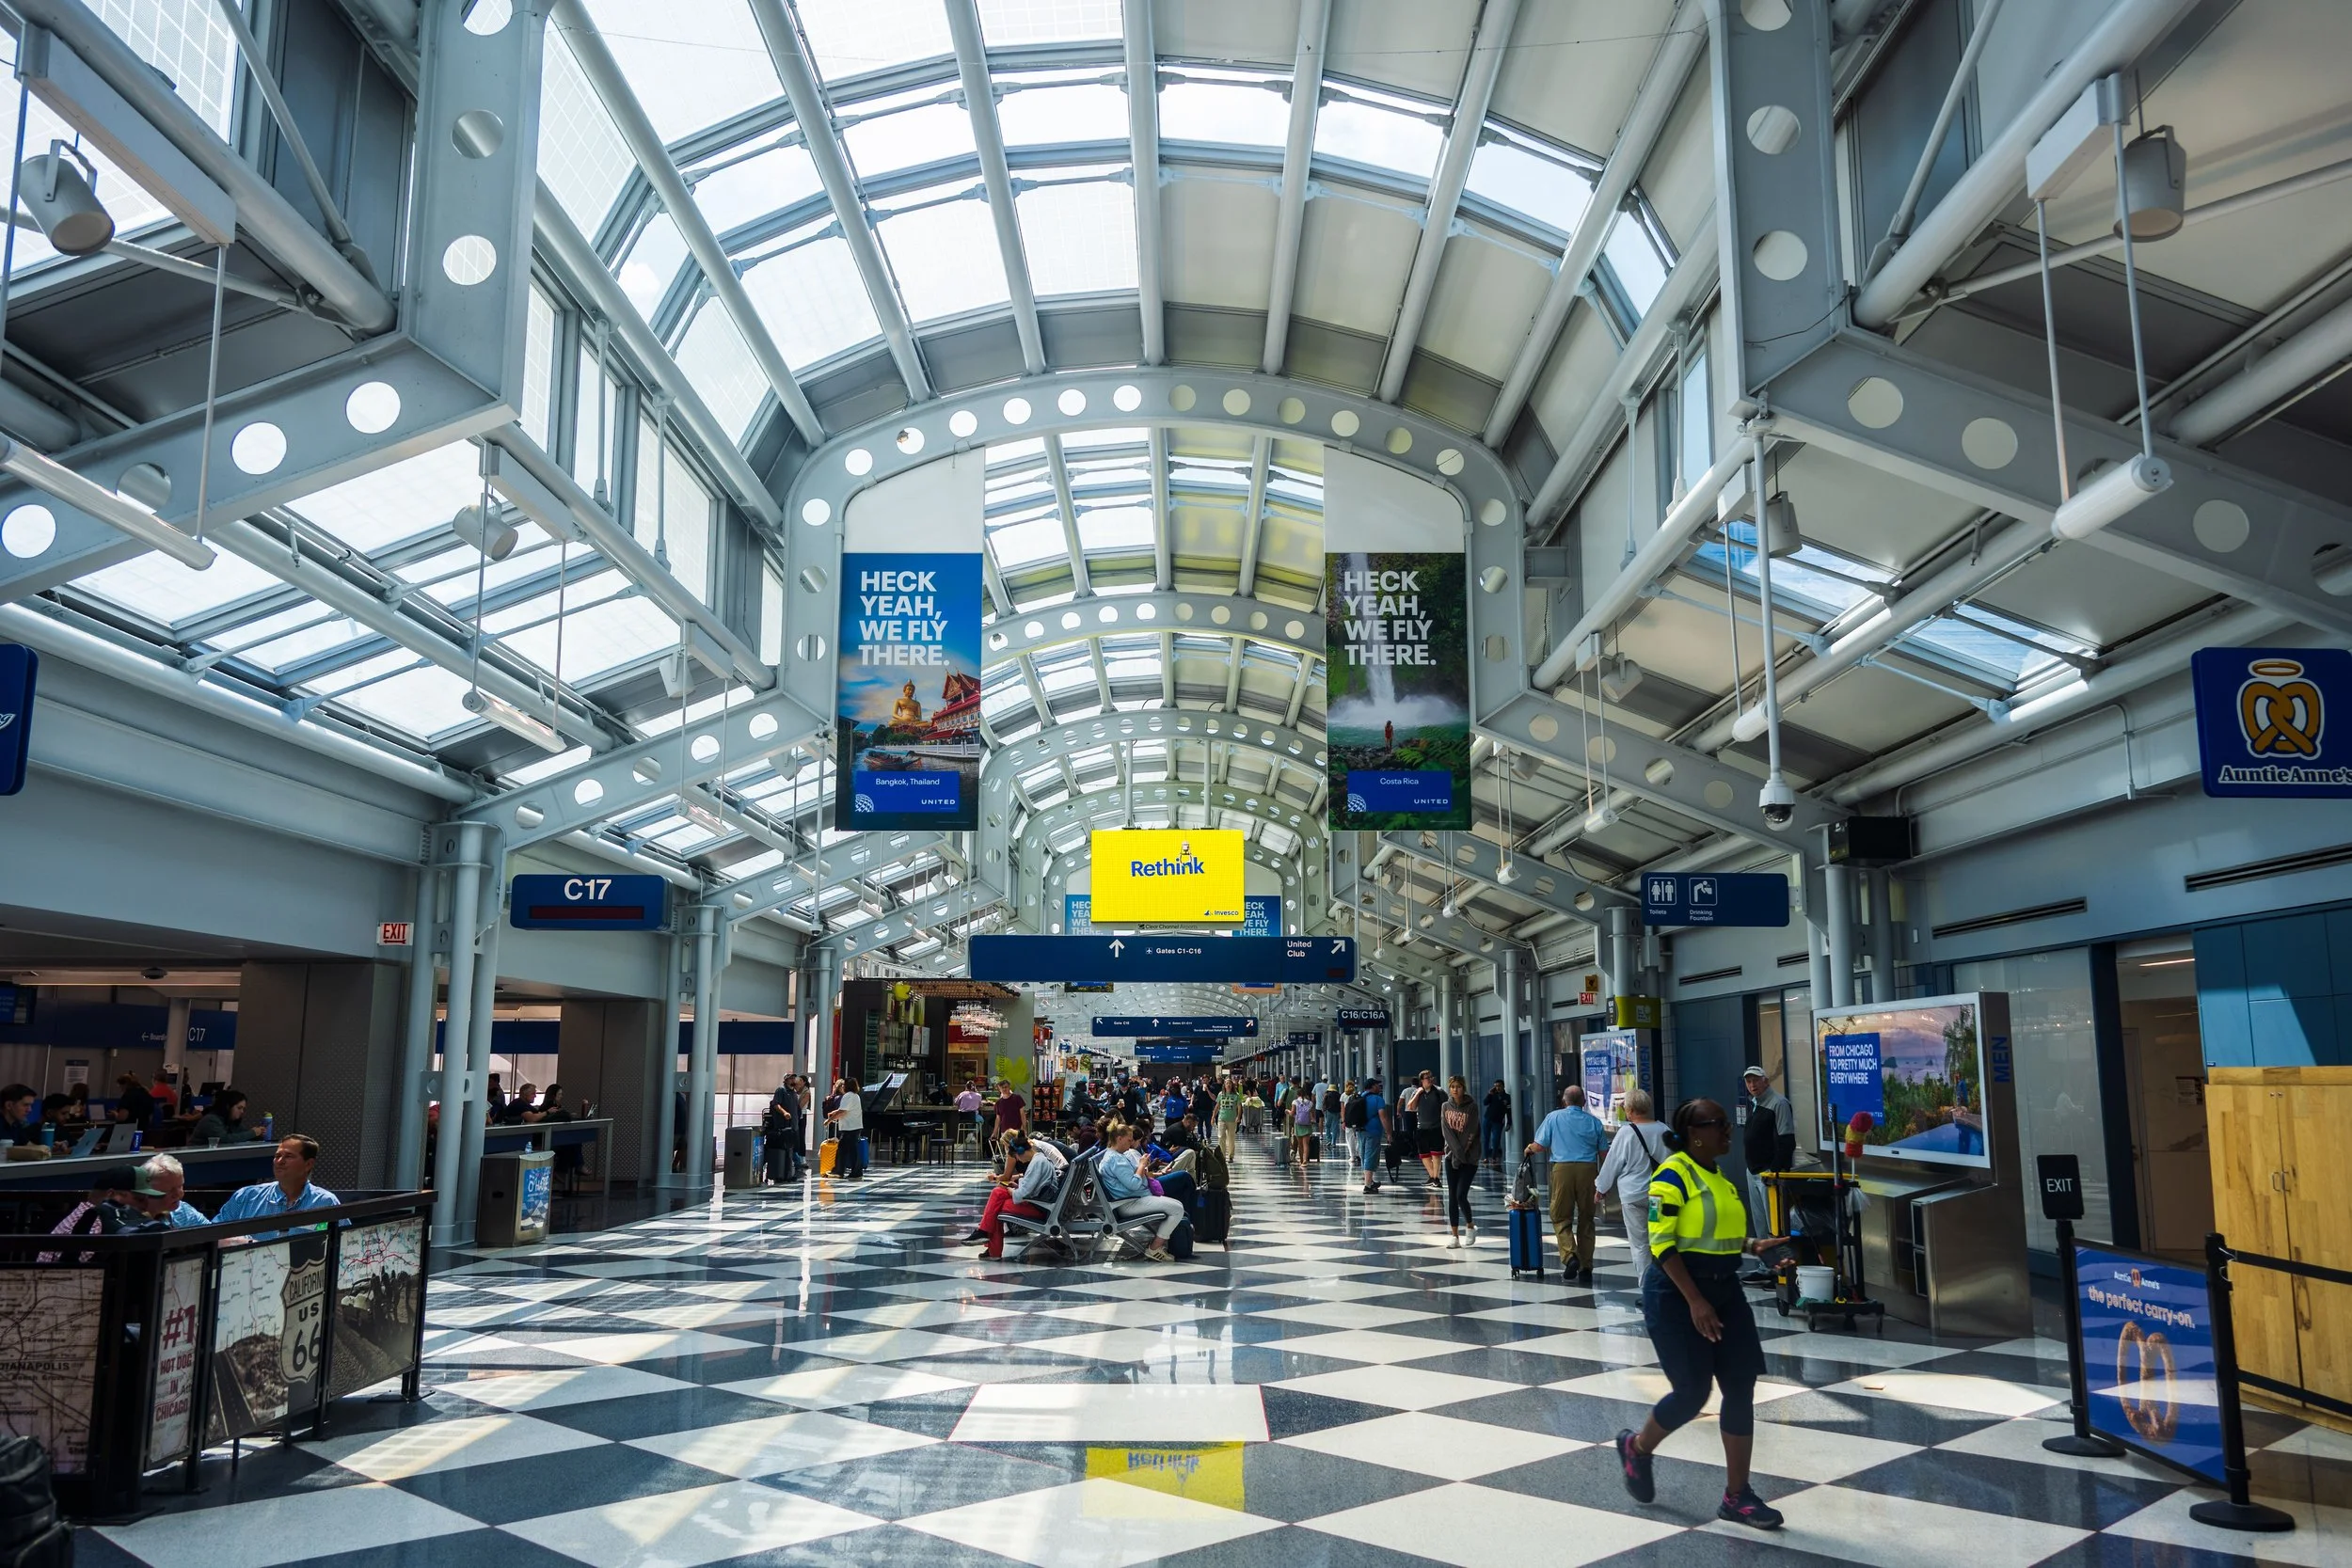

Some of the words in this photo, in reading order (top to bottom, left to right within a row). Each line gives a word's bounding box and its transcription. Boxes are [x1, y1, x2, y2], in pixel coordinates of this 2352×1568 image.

[861, 571, 937, 592] HECK
[1344, 570, 1421, 592] HECK
[860, 595, 942, 620] YEAH,
[1343, 595, 1426, 620] YEAH,
[859, 621, 902, 641] WE
[908, 621, 948, 641] FLY
[1343, 620, 1388, 641] WE
[1393, 620, 1433, 641] FLY
[858, 644, 950, 666] THERE.
[1344, 644, 1437, 666] THERE.
[875, 778, 909, 786] Bangkok,
[2218, 765, 2289, 784] Auntie
[2289, 765, 2352, 784] Anne's
[1131, 857, 1204, 877] Rethink
[564, 879, 612, 900] C17
[1072, 901, 1091, 910] HEC
[1072, 910, 1091, 918] YEA
[1245, 911, 1267, 920] EAH,
[383, 923, 407, 939] EXIT
[1072, 918, 1087, 927] WE
[1581, 993, 1594, 1002] EXIT
[1342, 1010, 1386, 1020] C16/C16A
[188, 1027, 206, 1041] C17
[1829, 1045, 1845, 1056] FROM
[1846, 1044, 1874, 1056] CHICAGO
[1992, 1037, 2010, 1083] MEN
[1830, 1059, 1837, 1070] TO
[1837, 1058, 1858, 1070] PRETTY
[1859, 1058, 1878, 1070] MUCH
[1831, 1072, 1868, 1085] EVERYWHERE
[2046, 1178, 2073, 1193] EXIT
[289, 1268, 325, 1302] CALIFORNI
[2114, 1271, 2132, 1283] Auntie
[298, 1302, 319, 1323] US
[2088, 1286, 2105, 1304] the
[2106, 1293, 2144, 1315] perfect
[2144, 1303, 2196, 1329] carry-on.
[163, 1305, 196, 1350] #1
[293, 1322, 321, 1372] 66
[160, 1357, 176, 1375] HOT
[177, 1354, 193, 1370] DOG
[169, 1379, 179, 1395] IN
[155, 1399, 189, 1422] CHICAGO
